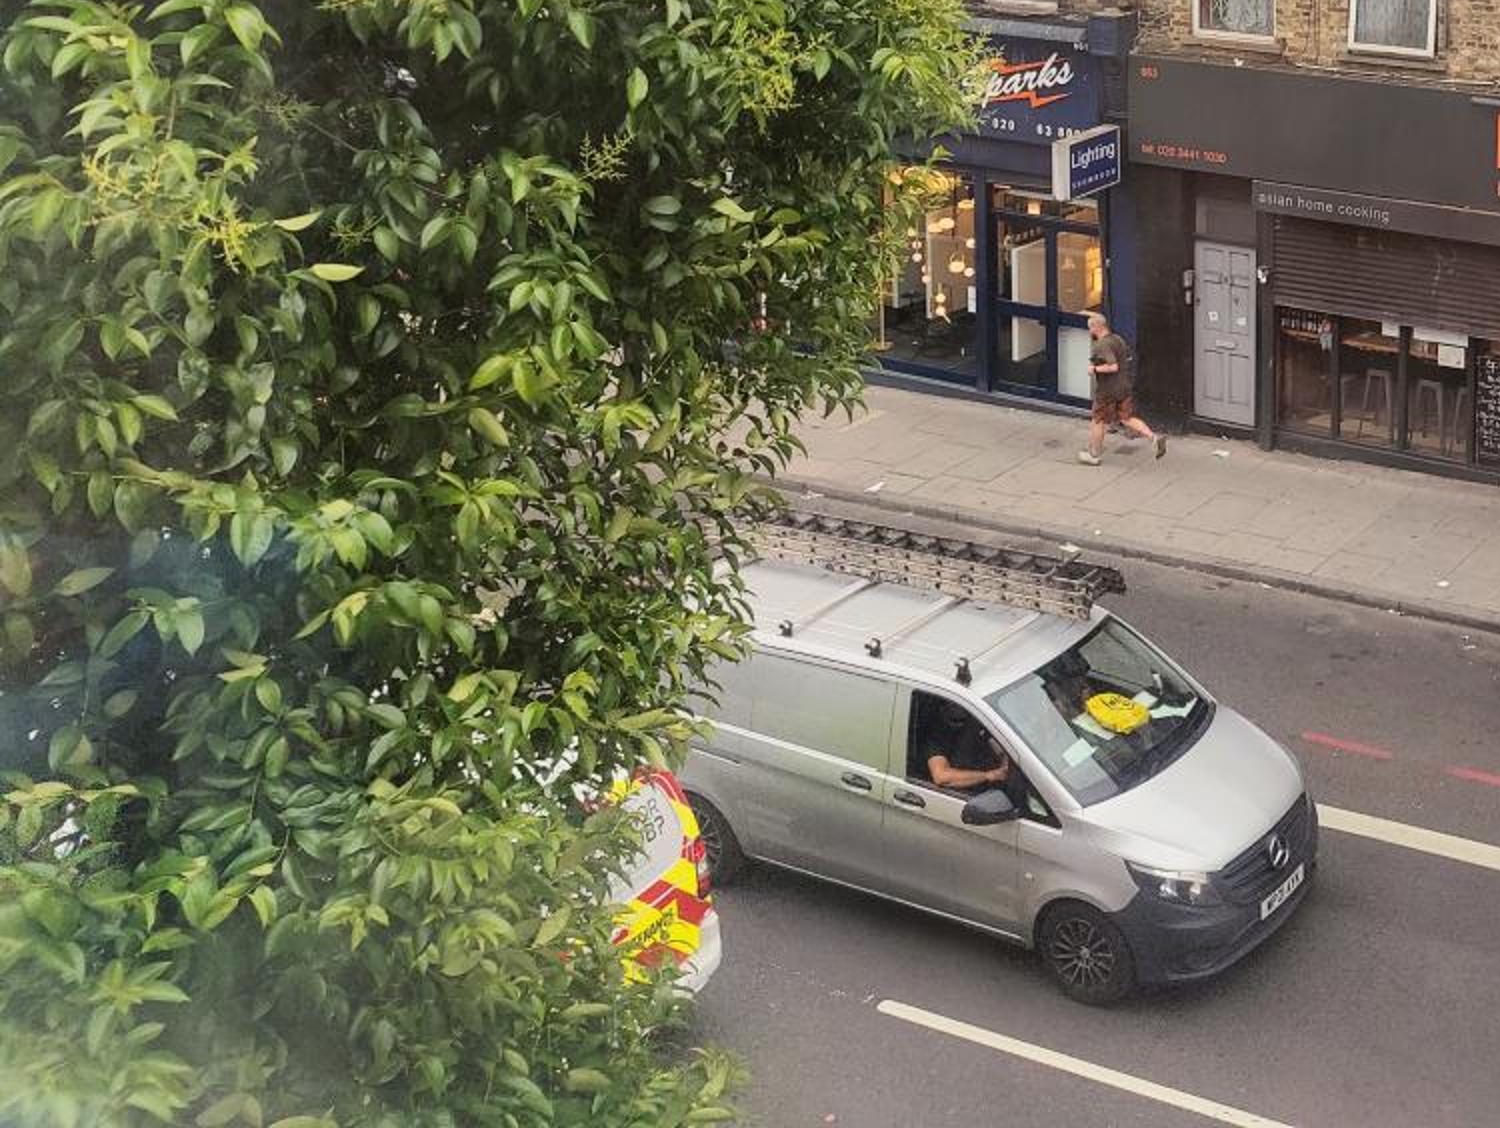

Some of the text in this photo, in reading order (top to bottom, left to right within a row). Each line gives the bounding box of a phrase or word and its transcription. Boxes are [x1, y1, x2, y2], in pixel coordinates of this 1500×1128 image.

[961, 51, 1075, 110] parks
[1071, 142, 1116, 170] Lighting
[1258, 192, 1390, 225] asian home cooking
